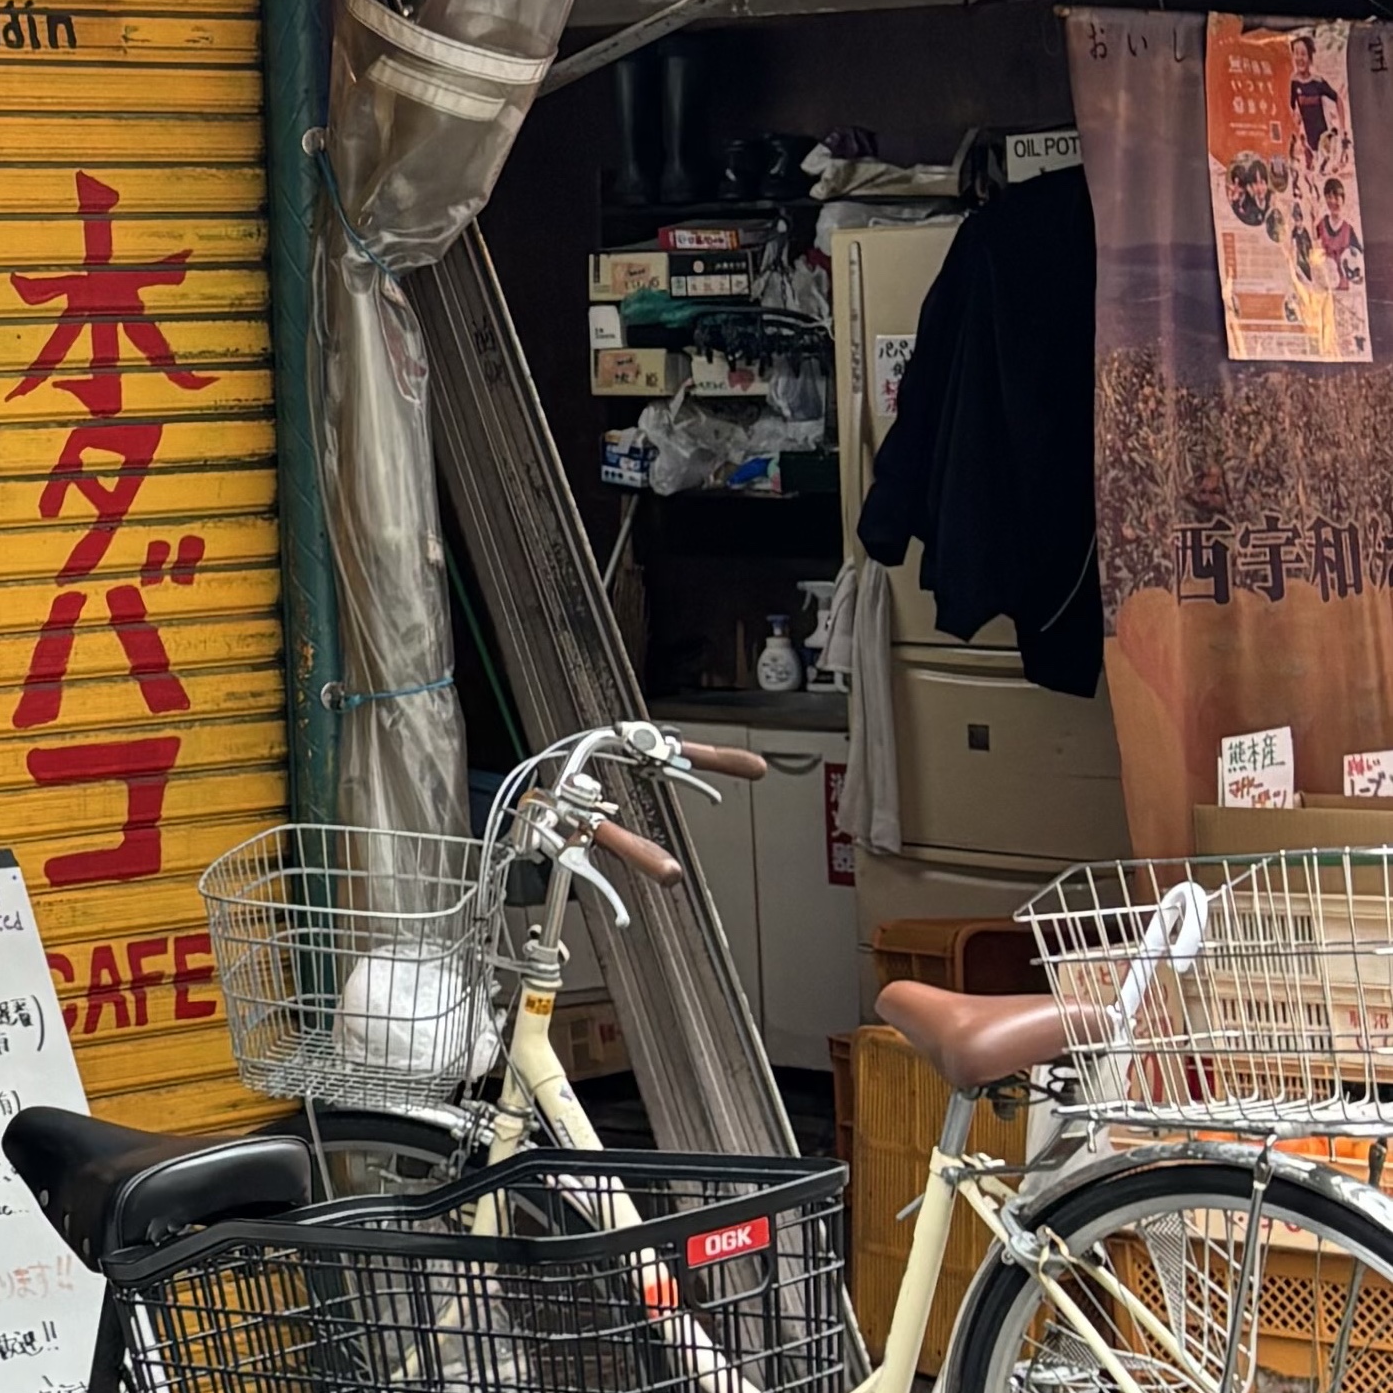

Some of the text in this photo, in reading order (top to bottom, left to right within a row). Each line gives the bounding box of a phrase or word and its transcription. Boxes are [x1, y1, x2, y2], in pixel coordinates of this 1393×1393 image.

[1014, 136, 1081, 159] OIL POT
[704, 1225, 753, 1257] OGK
